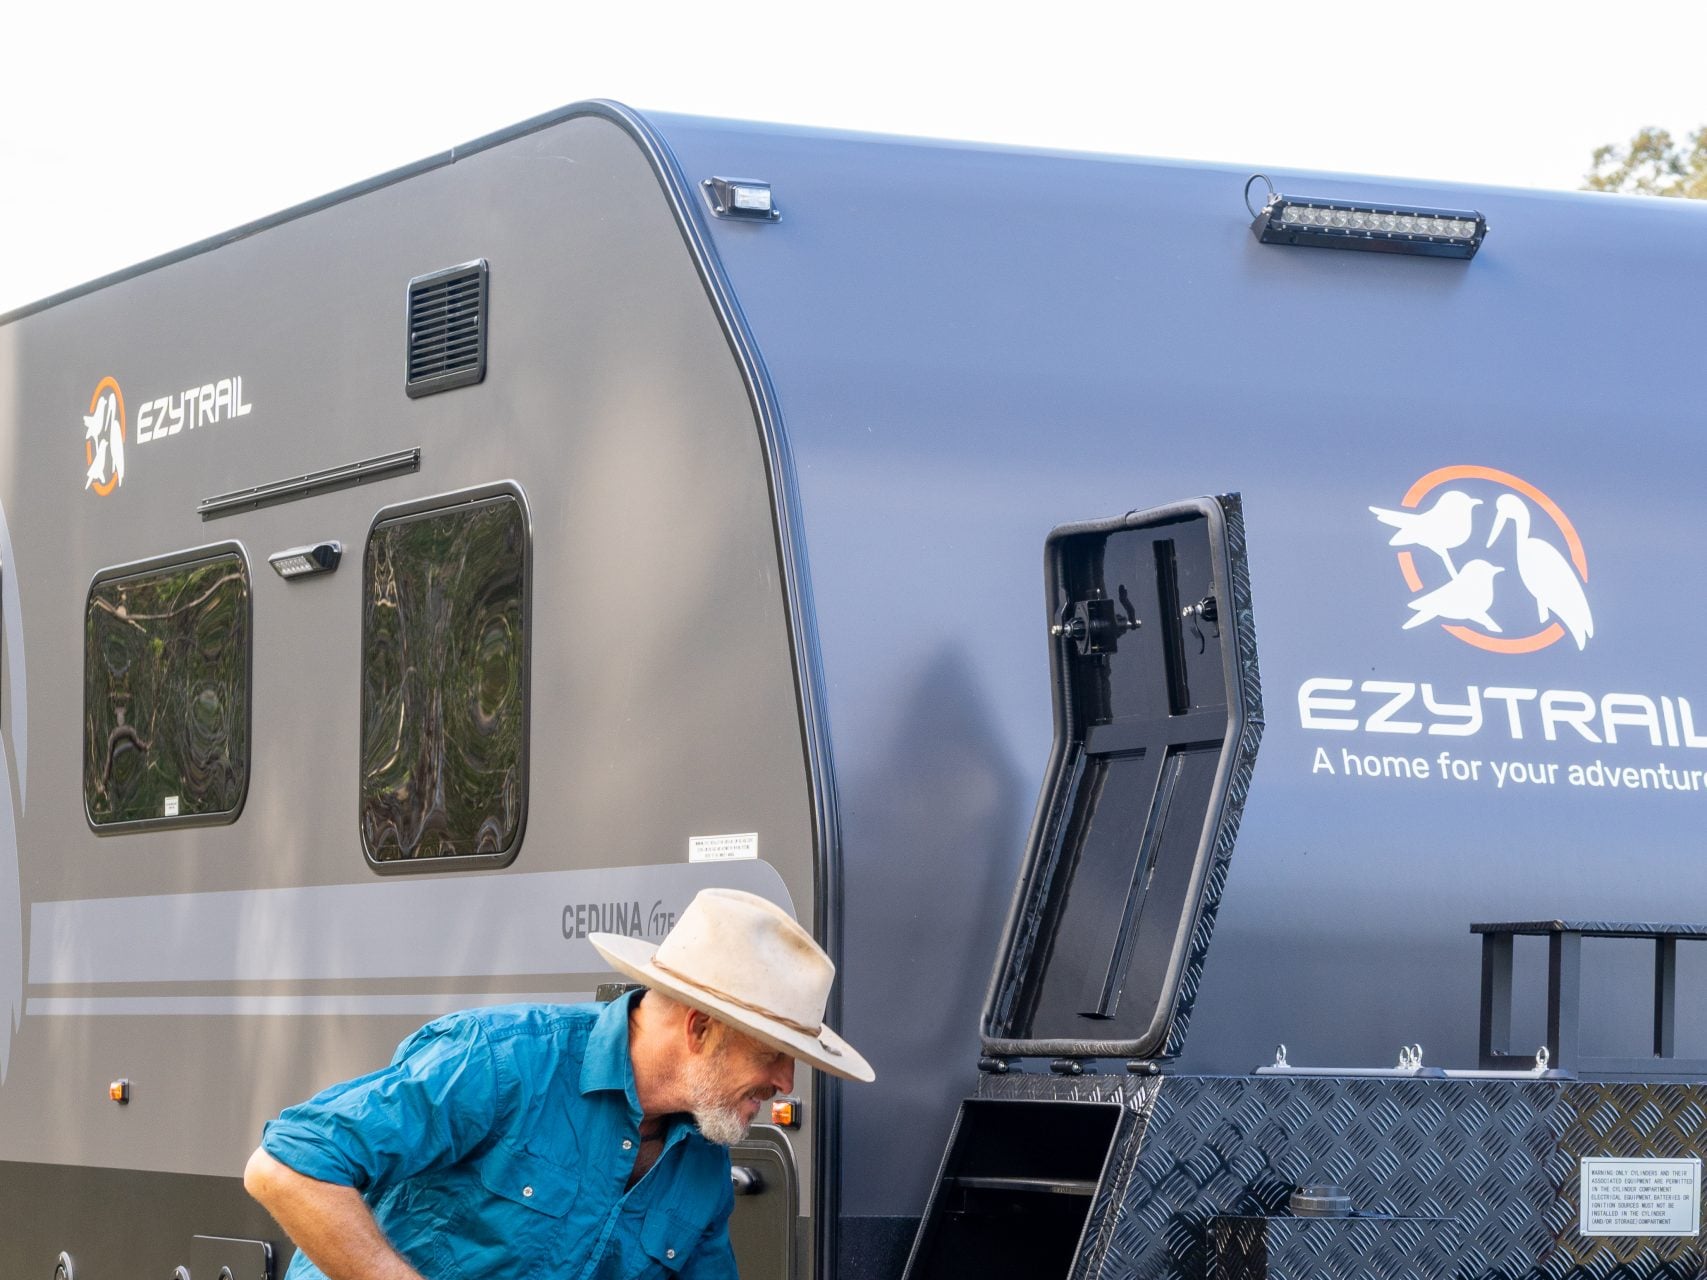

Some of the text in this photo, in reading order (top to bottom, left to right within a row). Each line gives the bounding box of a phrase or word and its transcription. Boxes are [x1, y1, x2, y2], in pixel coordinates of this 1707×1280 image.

[136, 375, 252, 445] EZYTRAIL
[1297, 677, 1707, 749] EZYTRAIL
[1312, 747, 1707, 791] A home for your adventur
[561, 901, 643, 940] CEDUNA
